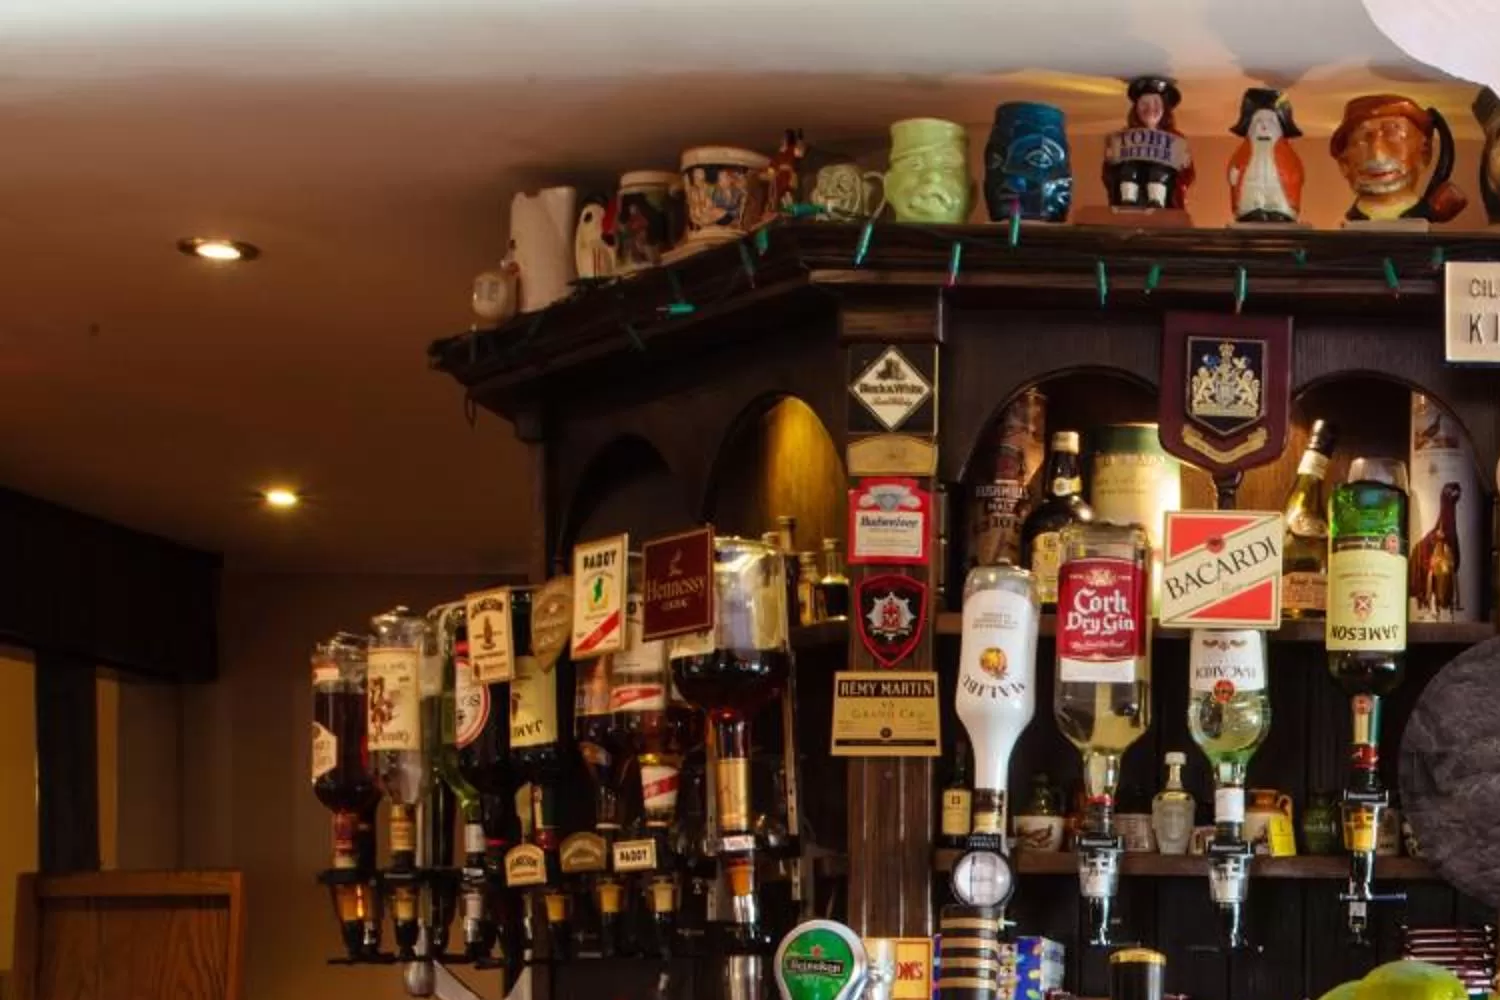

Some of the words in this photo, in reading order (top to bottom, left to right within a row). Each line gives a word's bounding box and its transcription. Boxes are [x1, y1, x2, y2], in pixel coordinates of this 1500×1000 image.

[583, 550, 617, 568] PADDY
[1165, 536, 1278, 600] BACARDI
[1074, 588, 1128, 614] Cork
[1065, 612, 1100, 636] Dry
[1102, 612, 1135, 637] Gin
[1331, 624, 1398, 641] JAMESON
[881, 682, 932, 695] MARTIN
[620, 851, 647, 861] PADDY
[791, 960, 840, 973] Heineken
